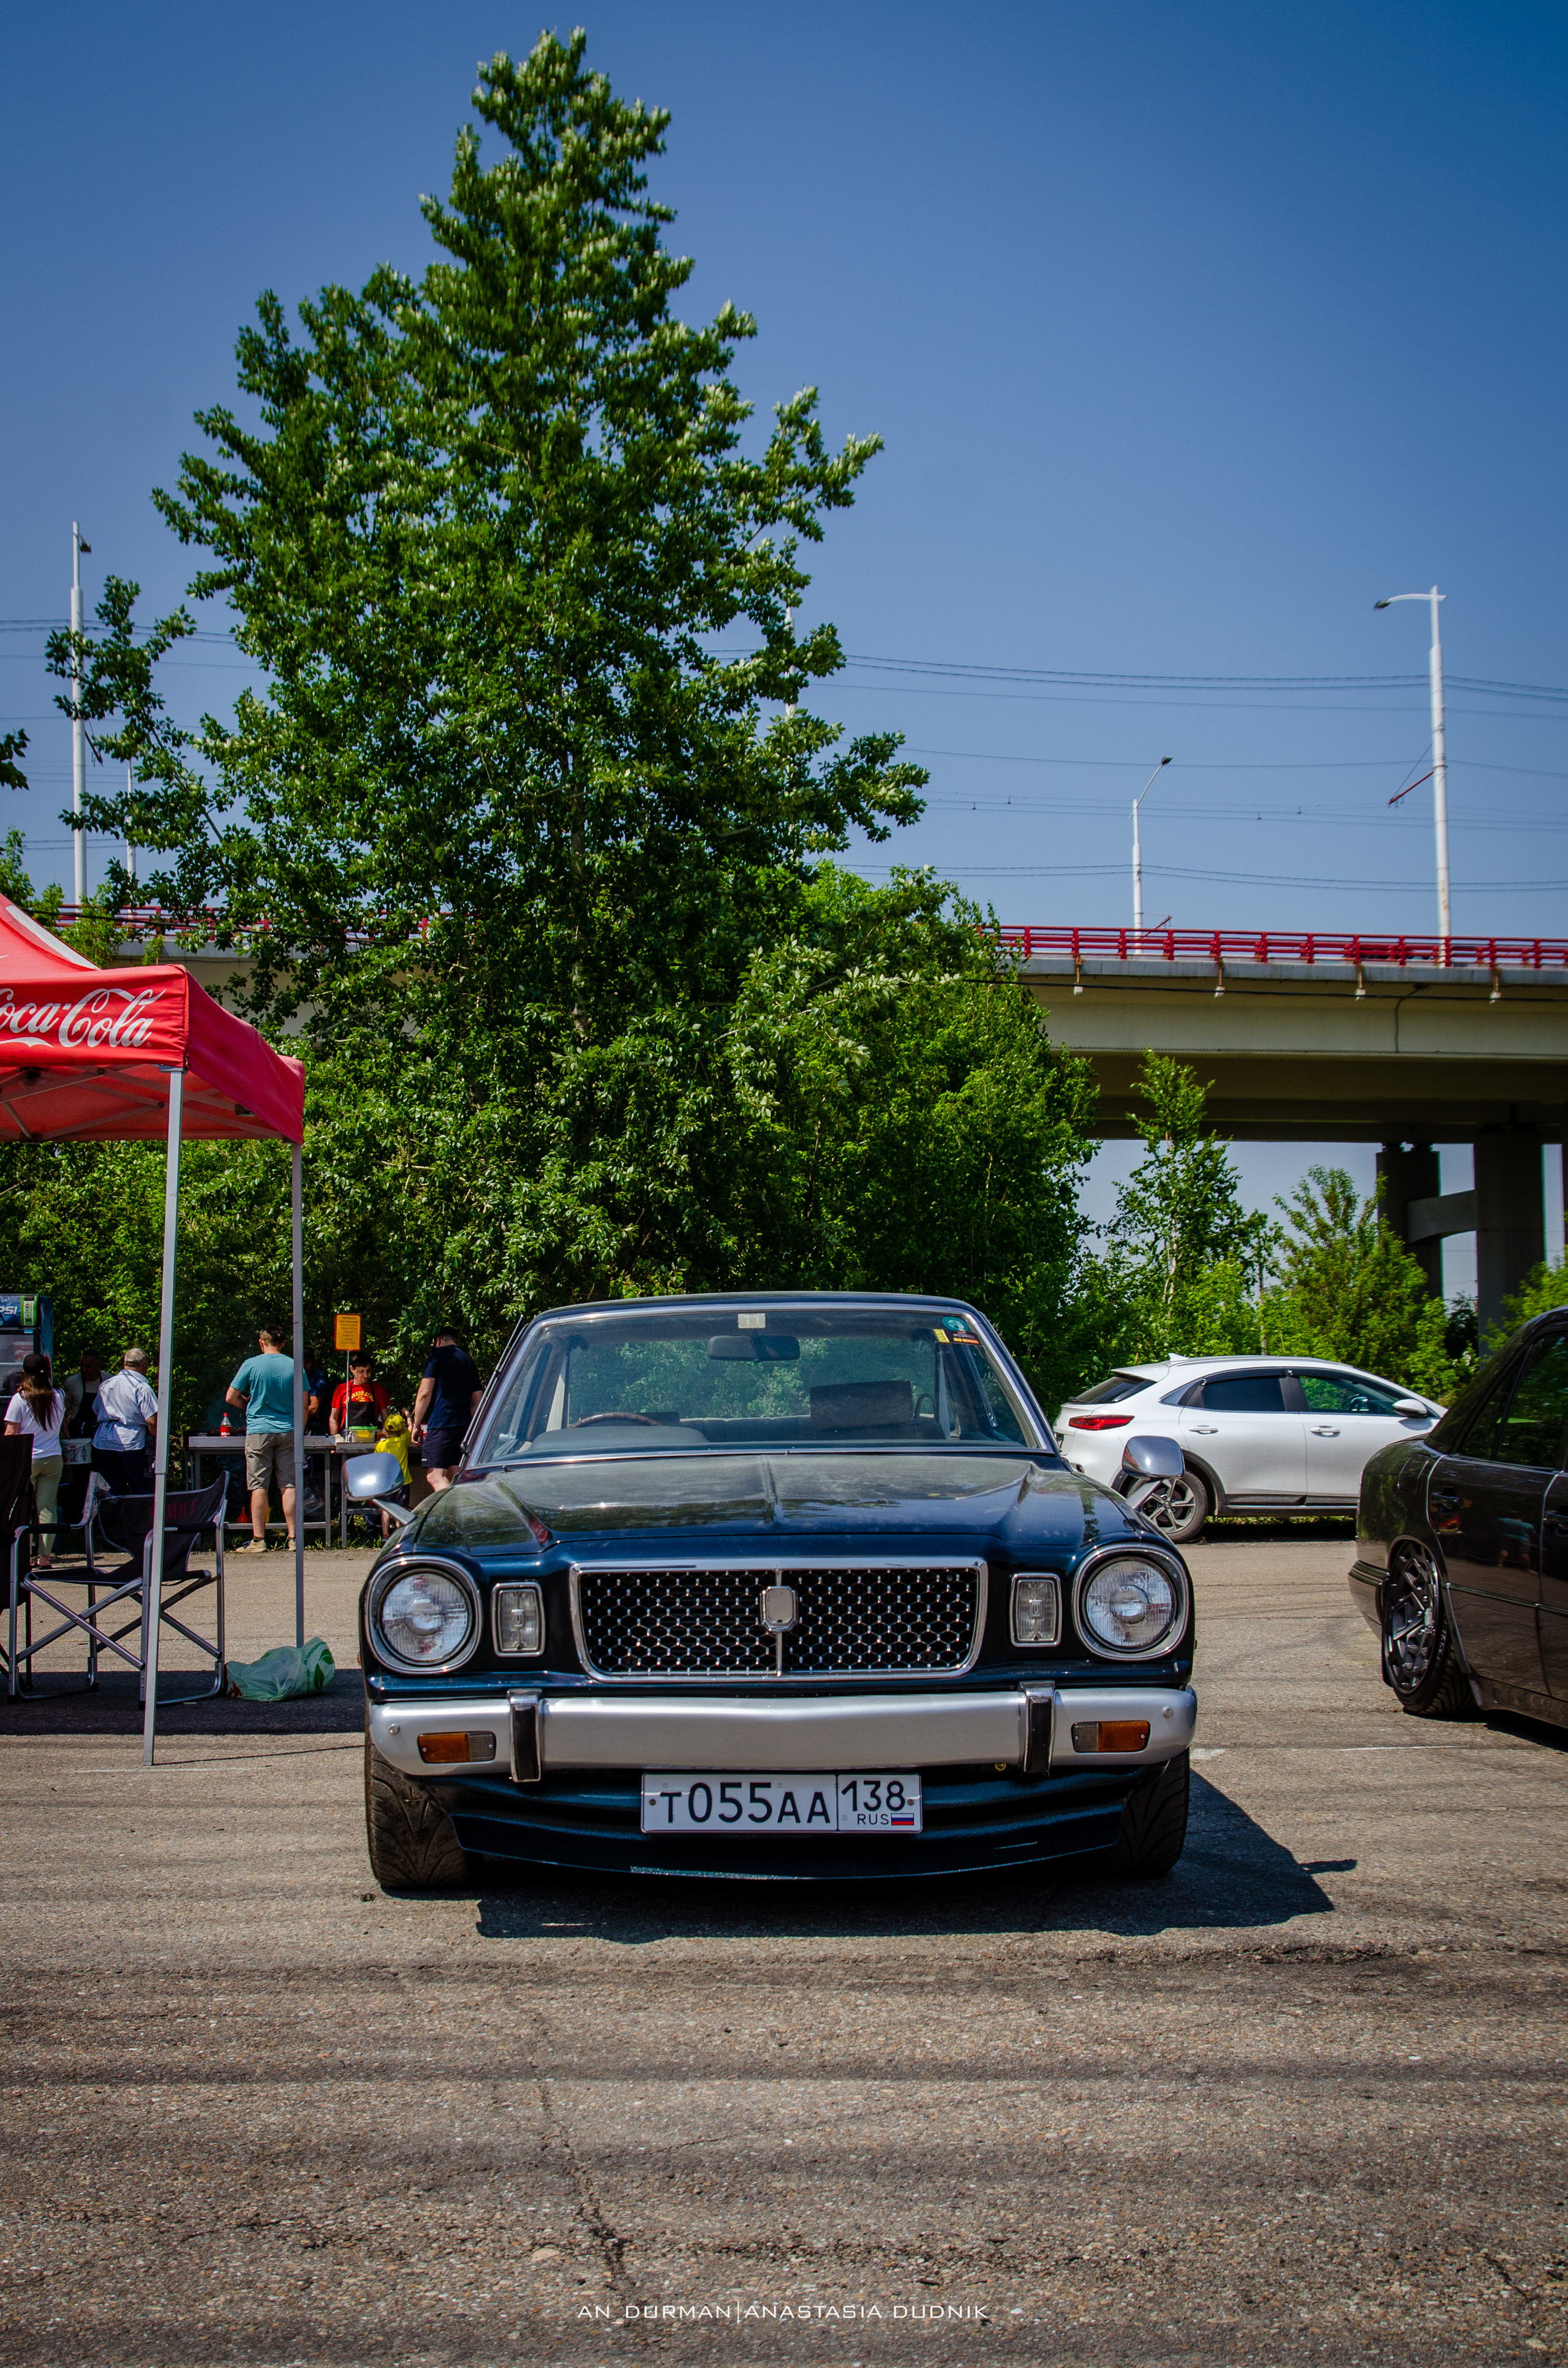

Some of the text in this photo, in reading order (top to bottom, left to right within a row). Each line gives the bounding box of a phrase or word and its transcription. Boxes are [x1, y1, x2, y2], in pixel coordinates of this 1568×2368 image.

[660, 1780, 906, 1824] T055AA 138
[858, 1814, 889, 1826] RUS
